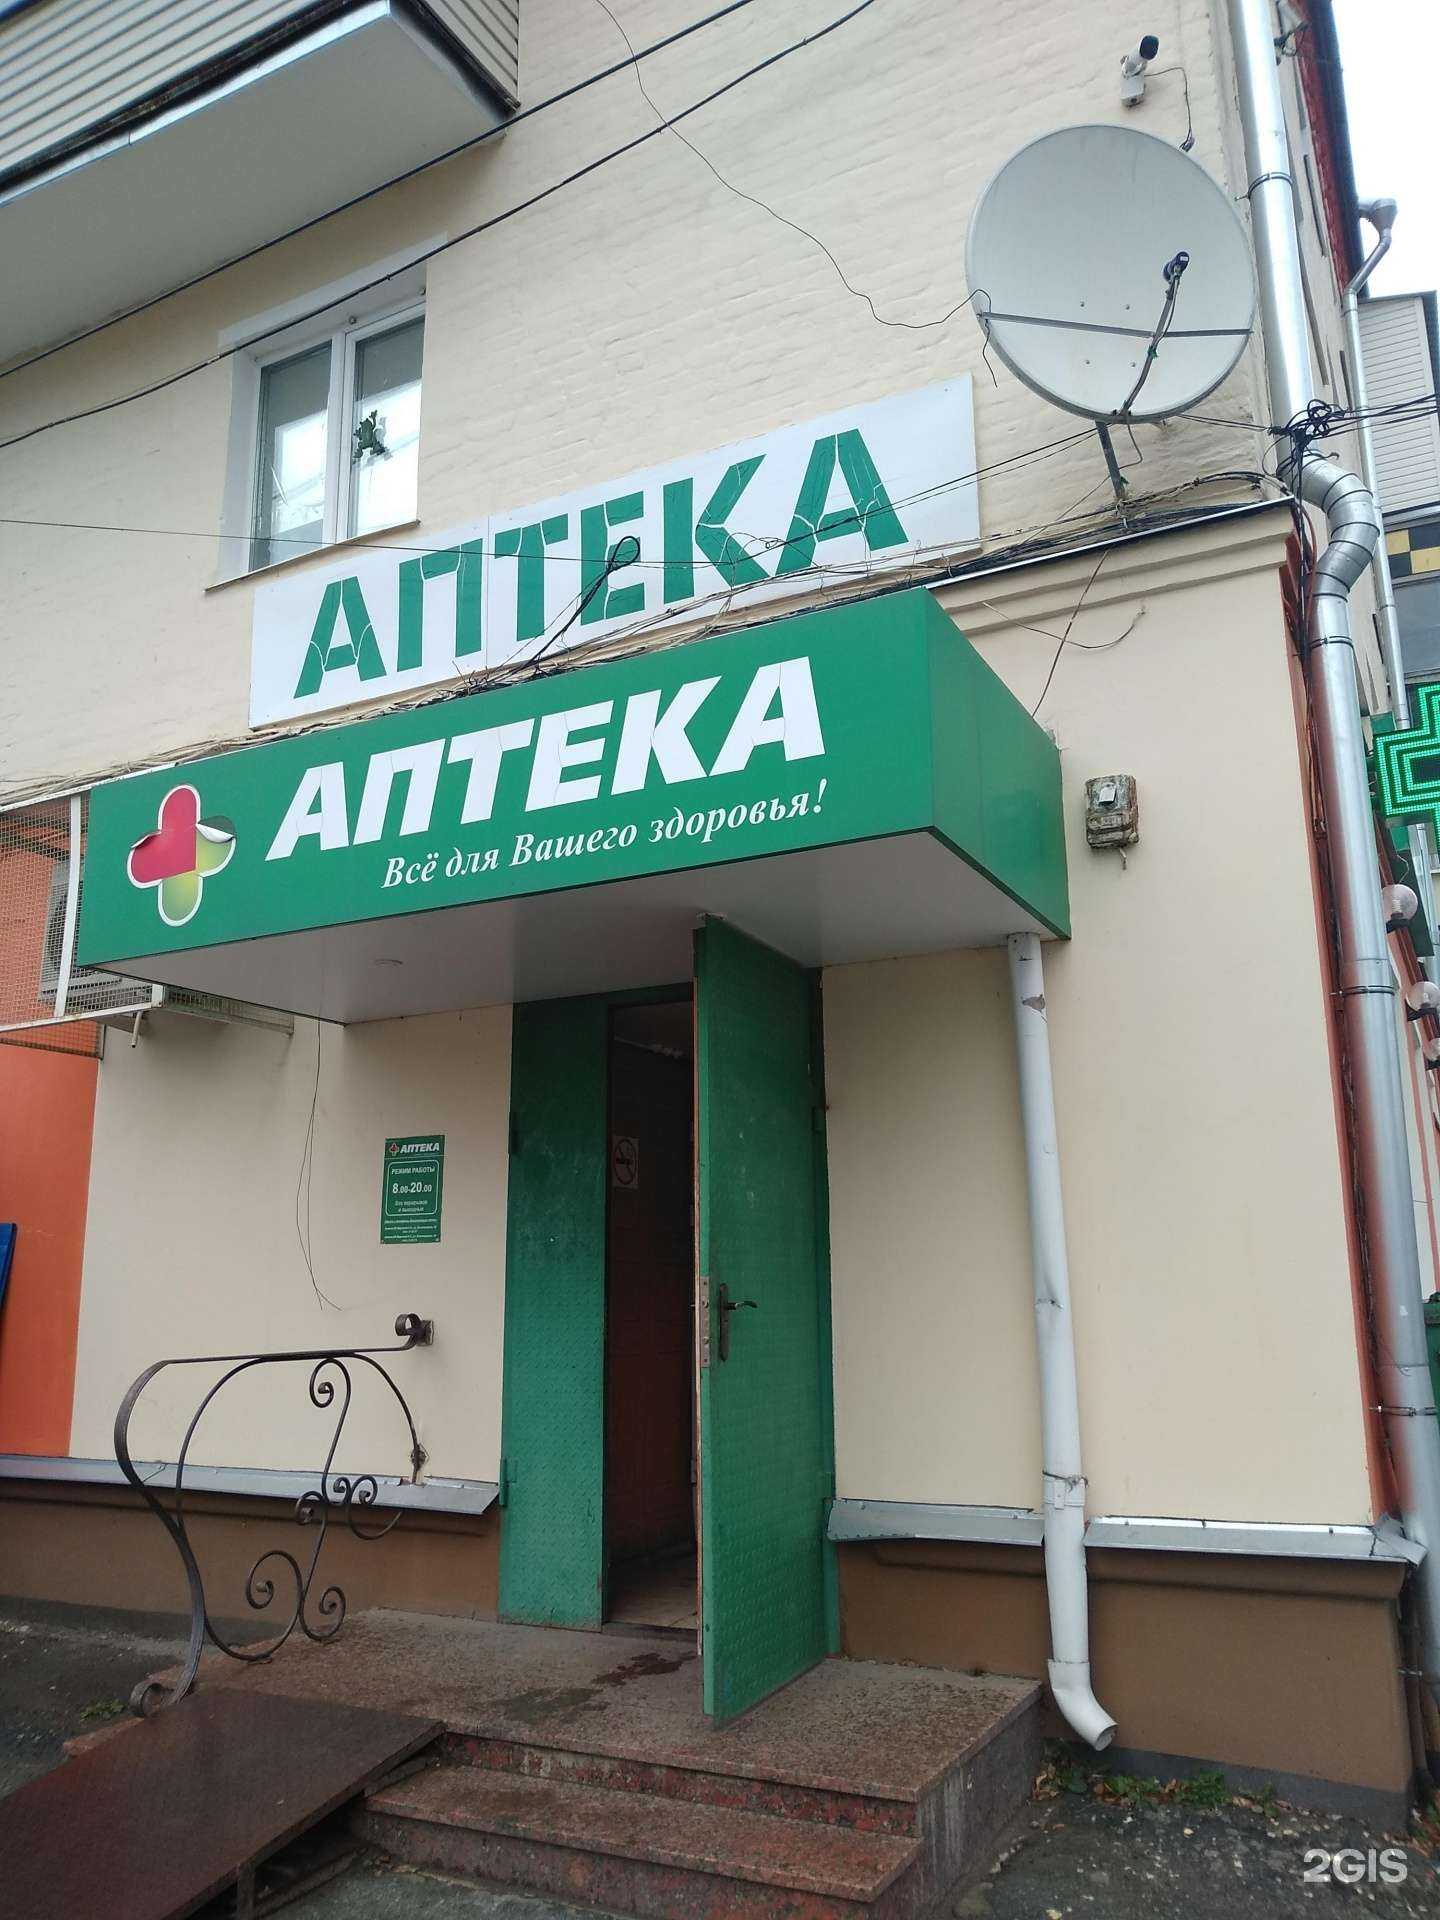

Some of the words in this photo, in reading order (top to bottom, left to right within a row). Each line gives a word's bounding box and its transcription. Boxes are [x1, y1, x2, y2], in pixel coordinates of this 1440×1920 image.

[294, 428, 909, 698] АПТЕКА
[265, 657, 826, 861] АПТЕКА
[381, 852, 438, 889] Всё
[445, 844, 500, 878] для
[509, 824, 638, 868] Вашего
[649, 778, 829, 845] здоровья!
[400, 1142, 440, 1154] АПТЕКА
